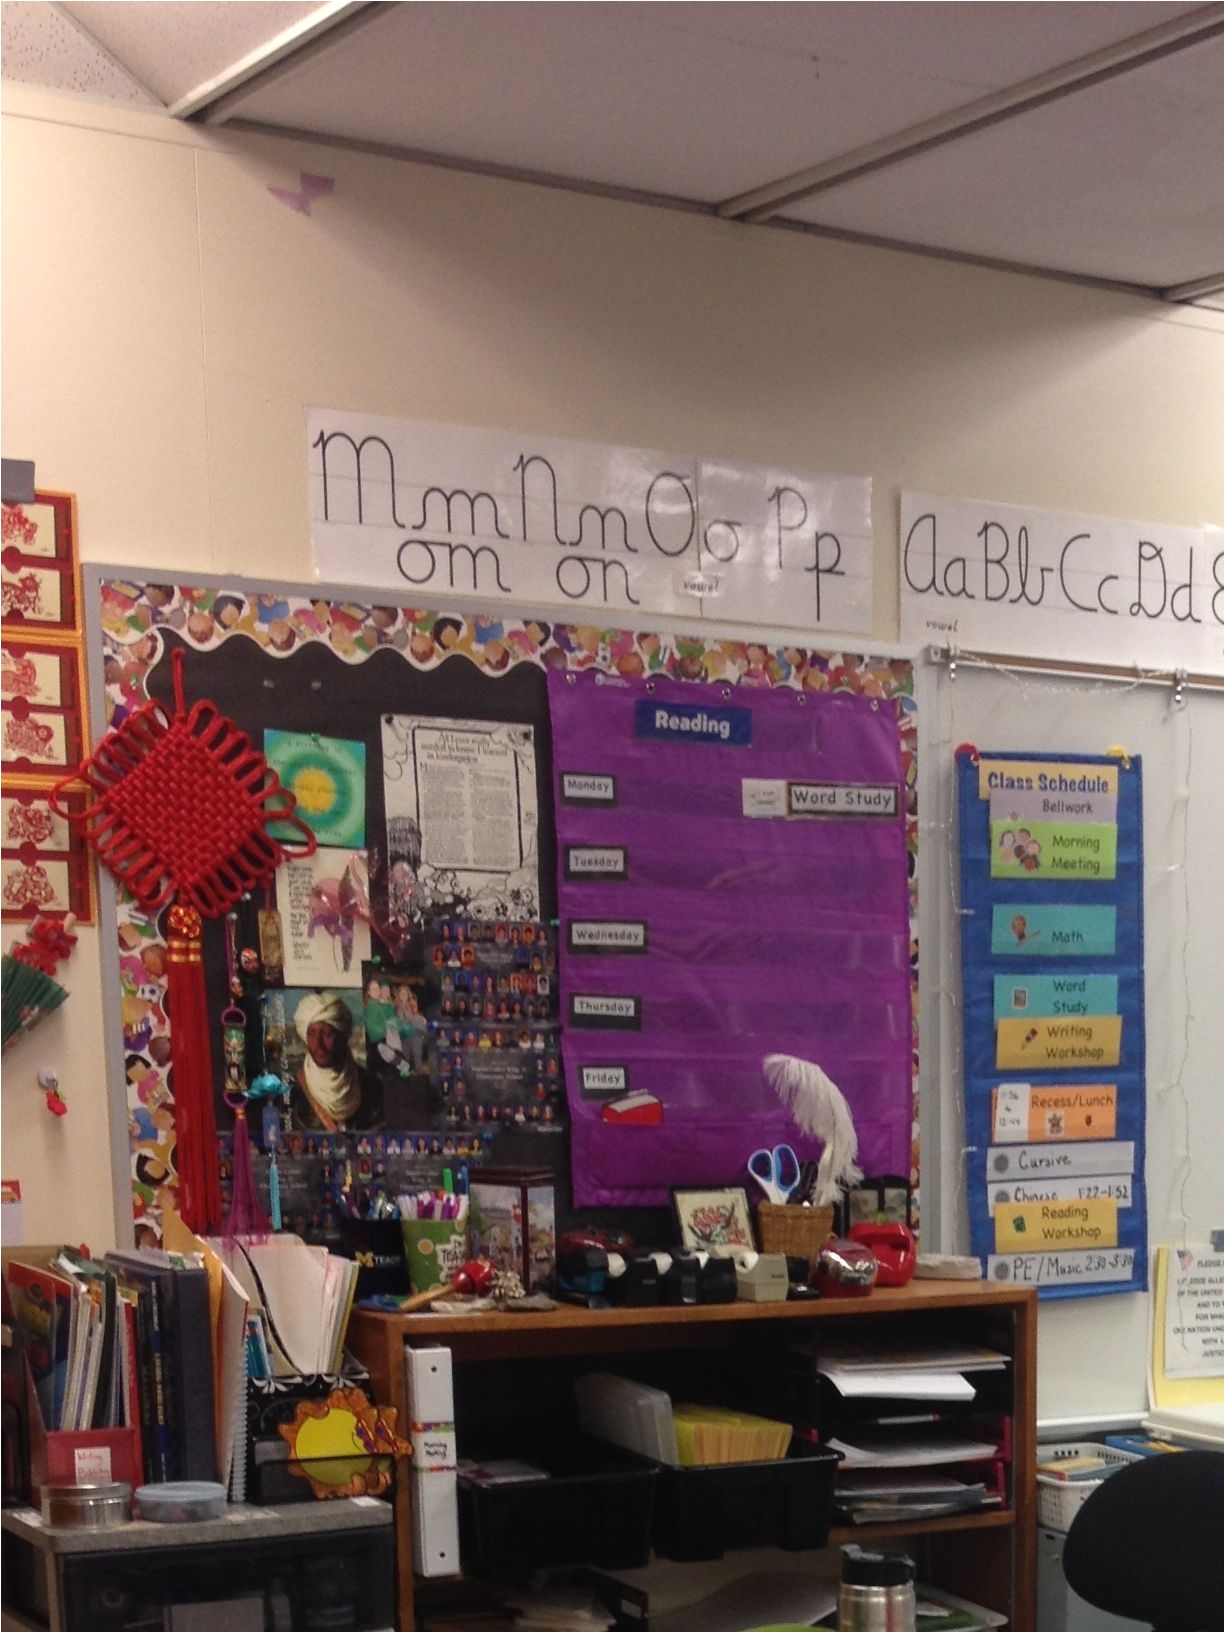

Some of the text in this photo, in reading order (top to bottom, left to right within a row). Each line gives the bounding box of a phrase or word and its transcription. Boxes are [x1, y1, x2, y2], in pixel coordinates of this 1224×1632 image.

[655, 709, 731, 740] Reading
[567, 778, 610, 794] Monday
[988, 772, 1110, 794] Class Schedule
[793, 788, 837, 805] Word
[845, 788, 892, 808] Study
[1042, 799, 1094, 814] Bellwork
[1052, 835, 1101, 854] Morning
[574, 856, 620, 870] Tuesday
[1051, 857, 1101, 875] Meeting
[576, 928, 641, 942] Wednesday
[1052, 931, 1083, 944] Math
[1052, 979, 1086, 992] Word
[579, 1001, 632, 1015] Thursday
[1053, 1000, 1088, 1016] Study
[1046, 1026, 1094, 1041] Writing
[1046, 1046, 1104, 1061] Workshop
[585, 1071, 621, 1087] Friday
[1031, 1093, 1113, 1109] Recess/Lunch
[1018, 1150, 1072, 1171] Cursive
[1014, 1186, 1059, 1202] Chinese
[1041, 1205, 1089, 1221] Reading
[1041, 1226, 1102, 1240] Workshop
